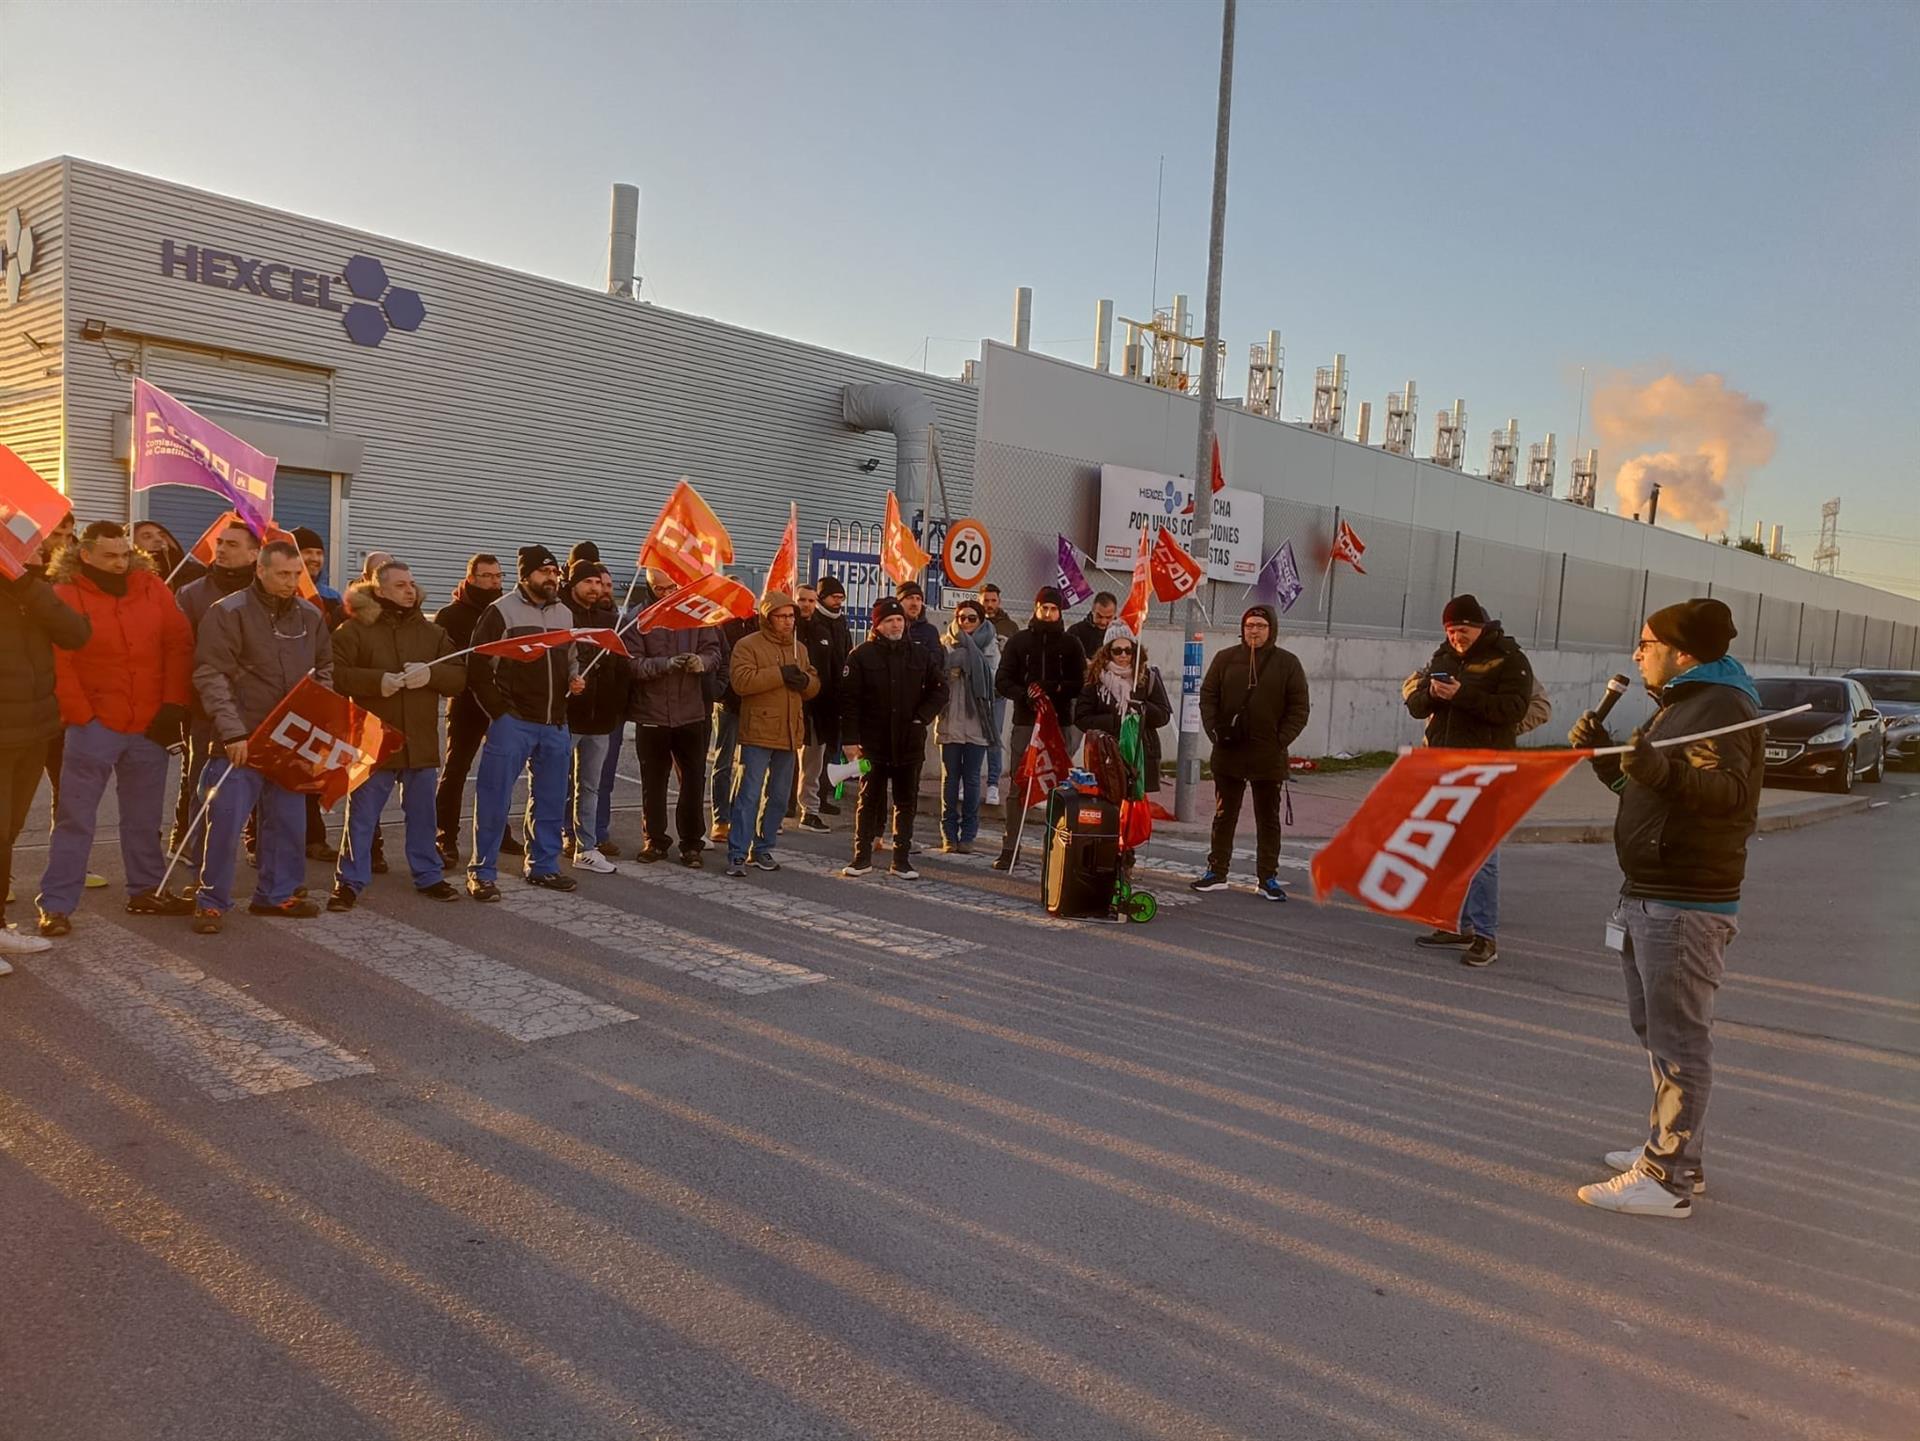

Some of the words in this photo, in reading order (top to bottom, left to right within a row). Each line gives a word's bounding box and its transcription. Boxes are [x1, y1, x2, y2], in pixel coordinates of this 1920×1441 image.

[162, 239, 342, 313] HEXCEL
[145, 412, 230, 480] COO
[1213, 499, 1231, 518] CHA
[955, 540, 982, 566] 20
[1154, 546, 1194, 593] COO
[1359, 764, 1518, 911] CCOO
